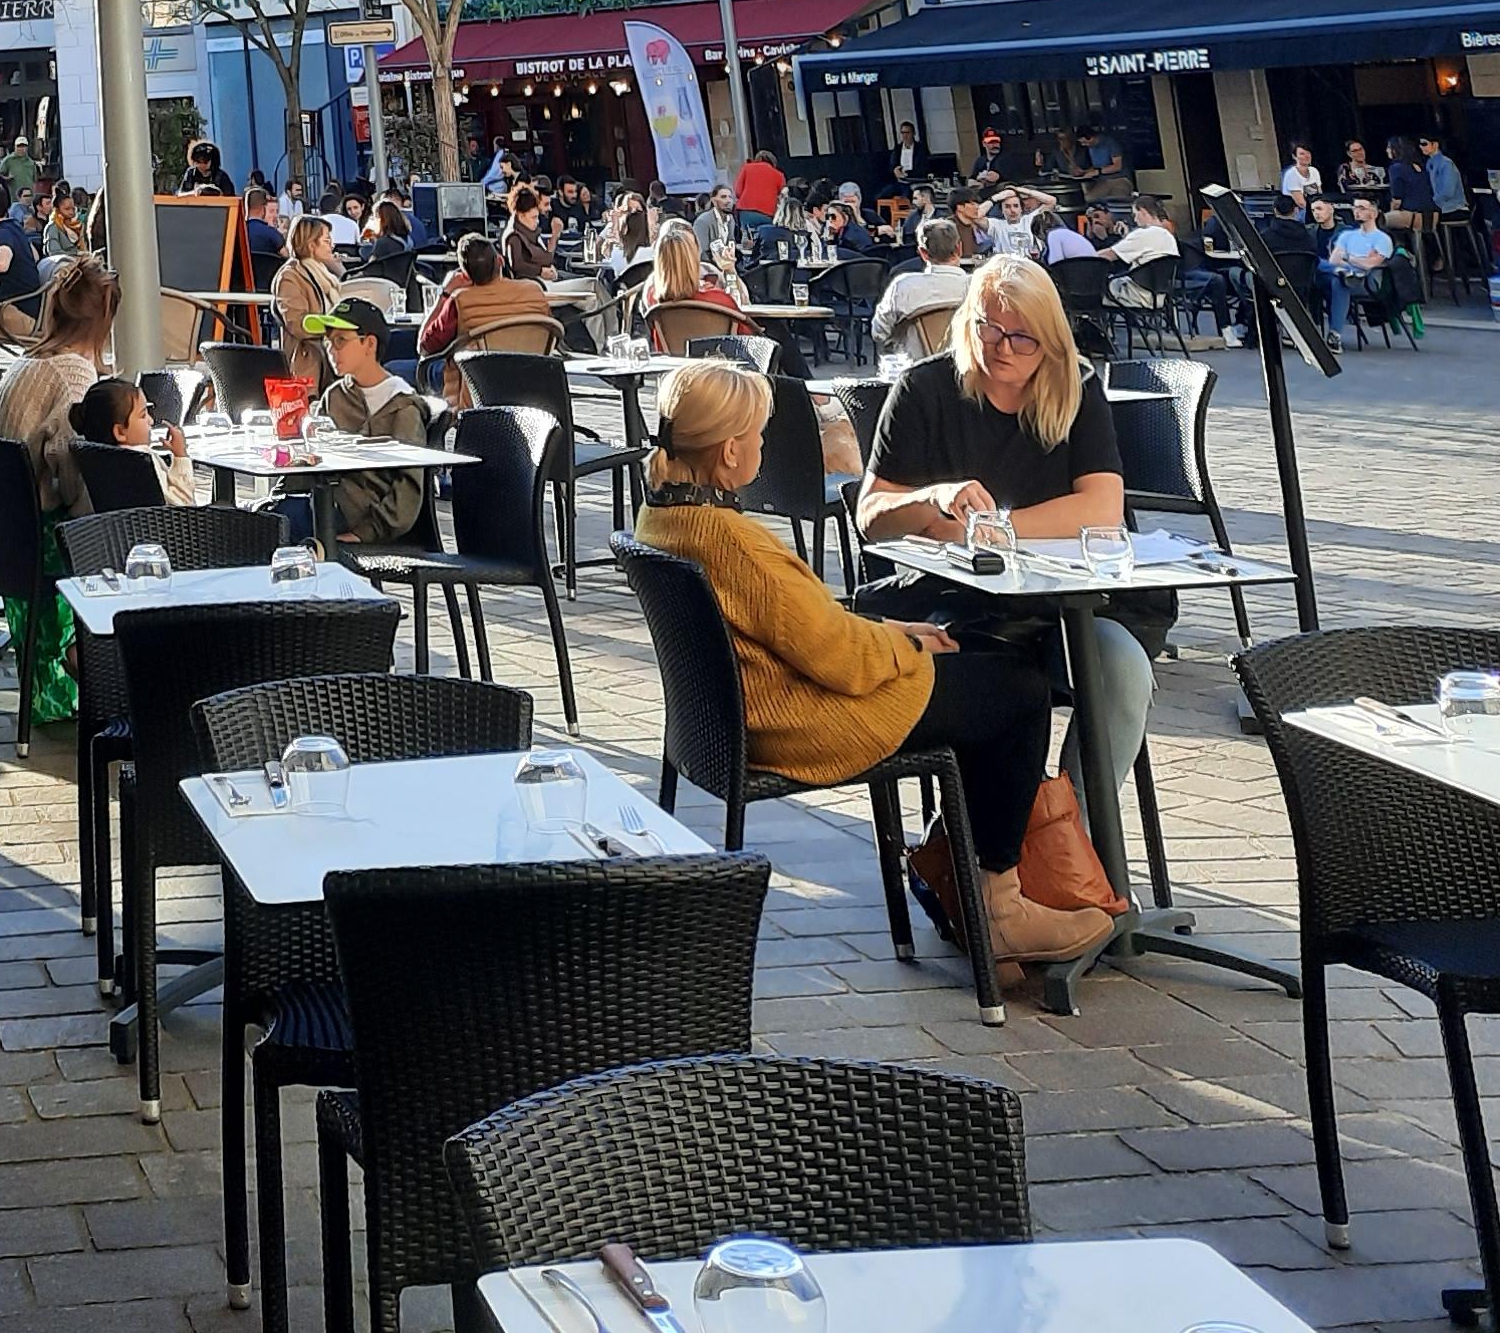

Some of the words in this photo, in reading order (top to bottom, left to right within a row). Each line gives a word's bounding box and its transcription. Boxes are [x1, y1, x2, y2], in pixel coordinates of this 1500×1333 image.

[516, 59, 565, 75] BISTROT
[568, 57, 585, 71] DE
[588, 55, 605, 70] LA
[1099, 48, 1210, 75] SAINT-PIERRE
[825, 72, 840, 85] Bar
